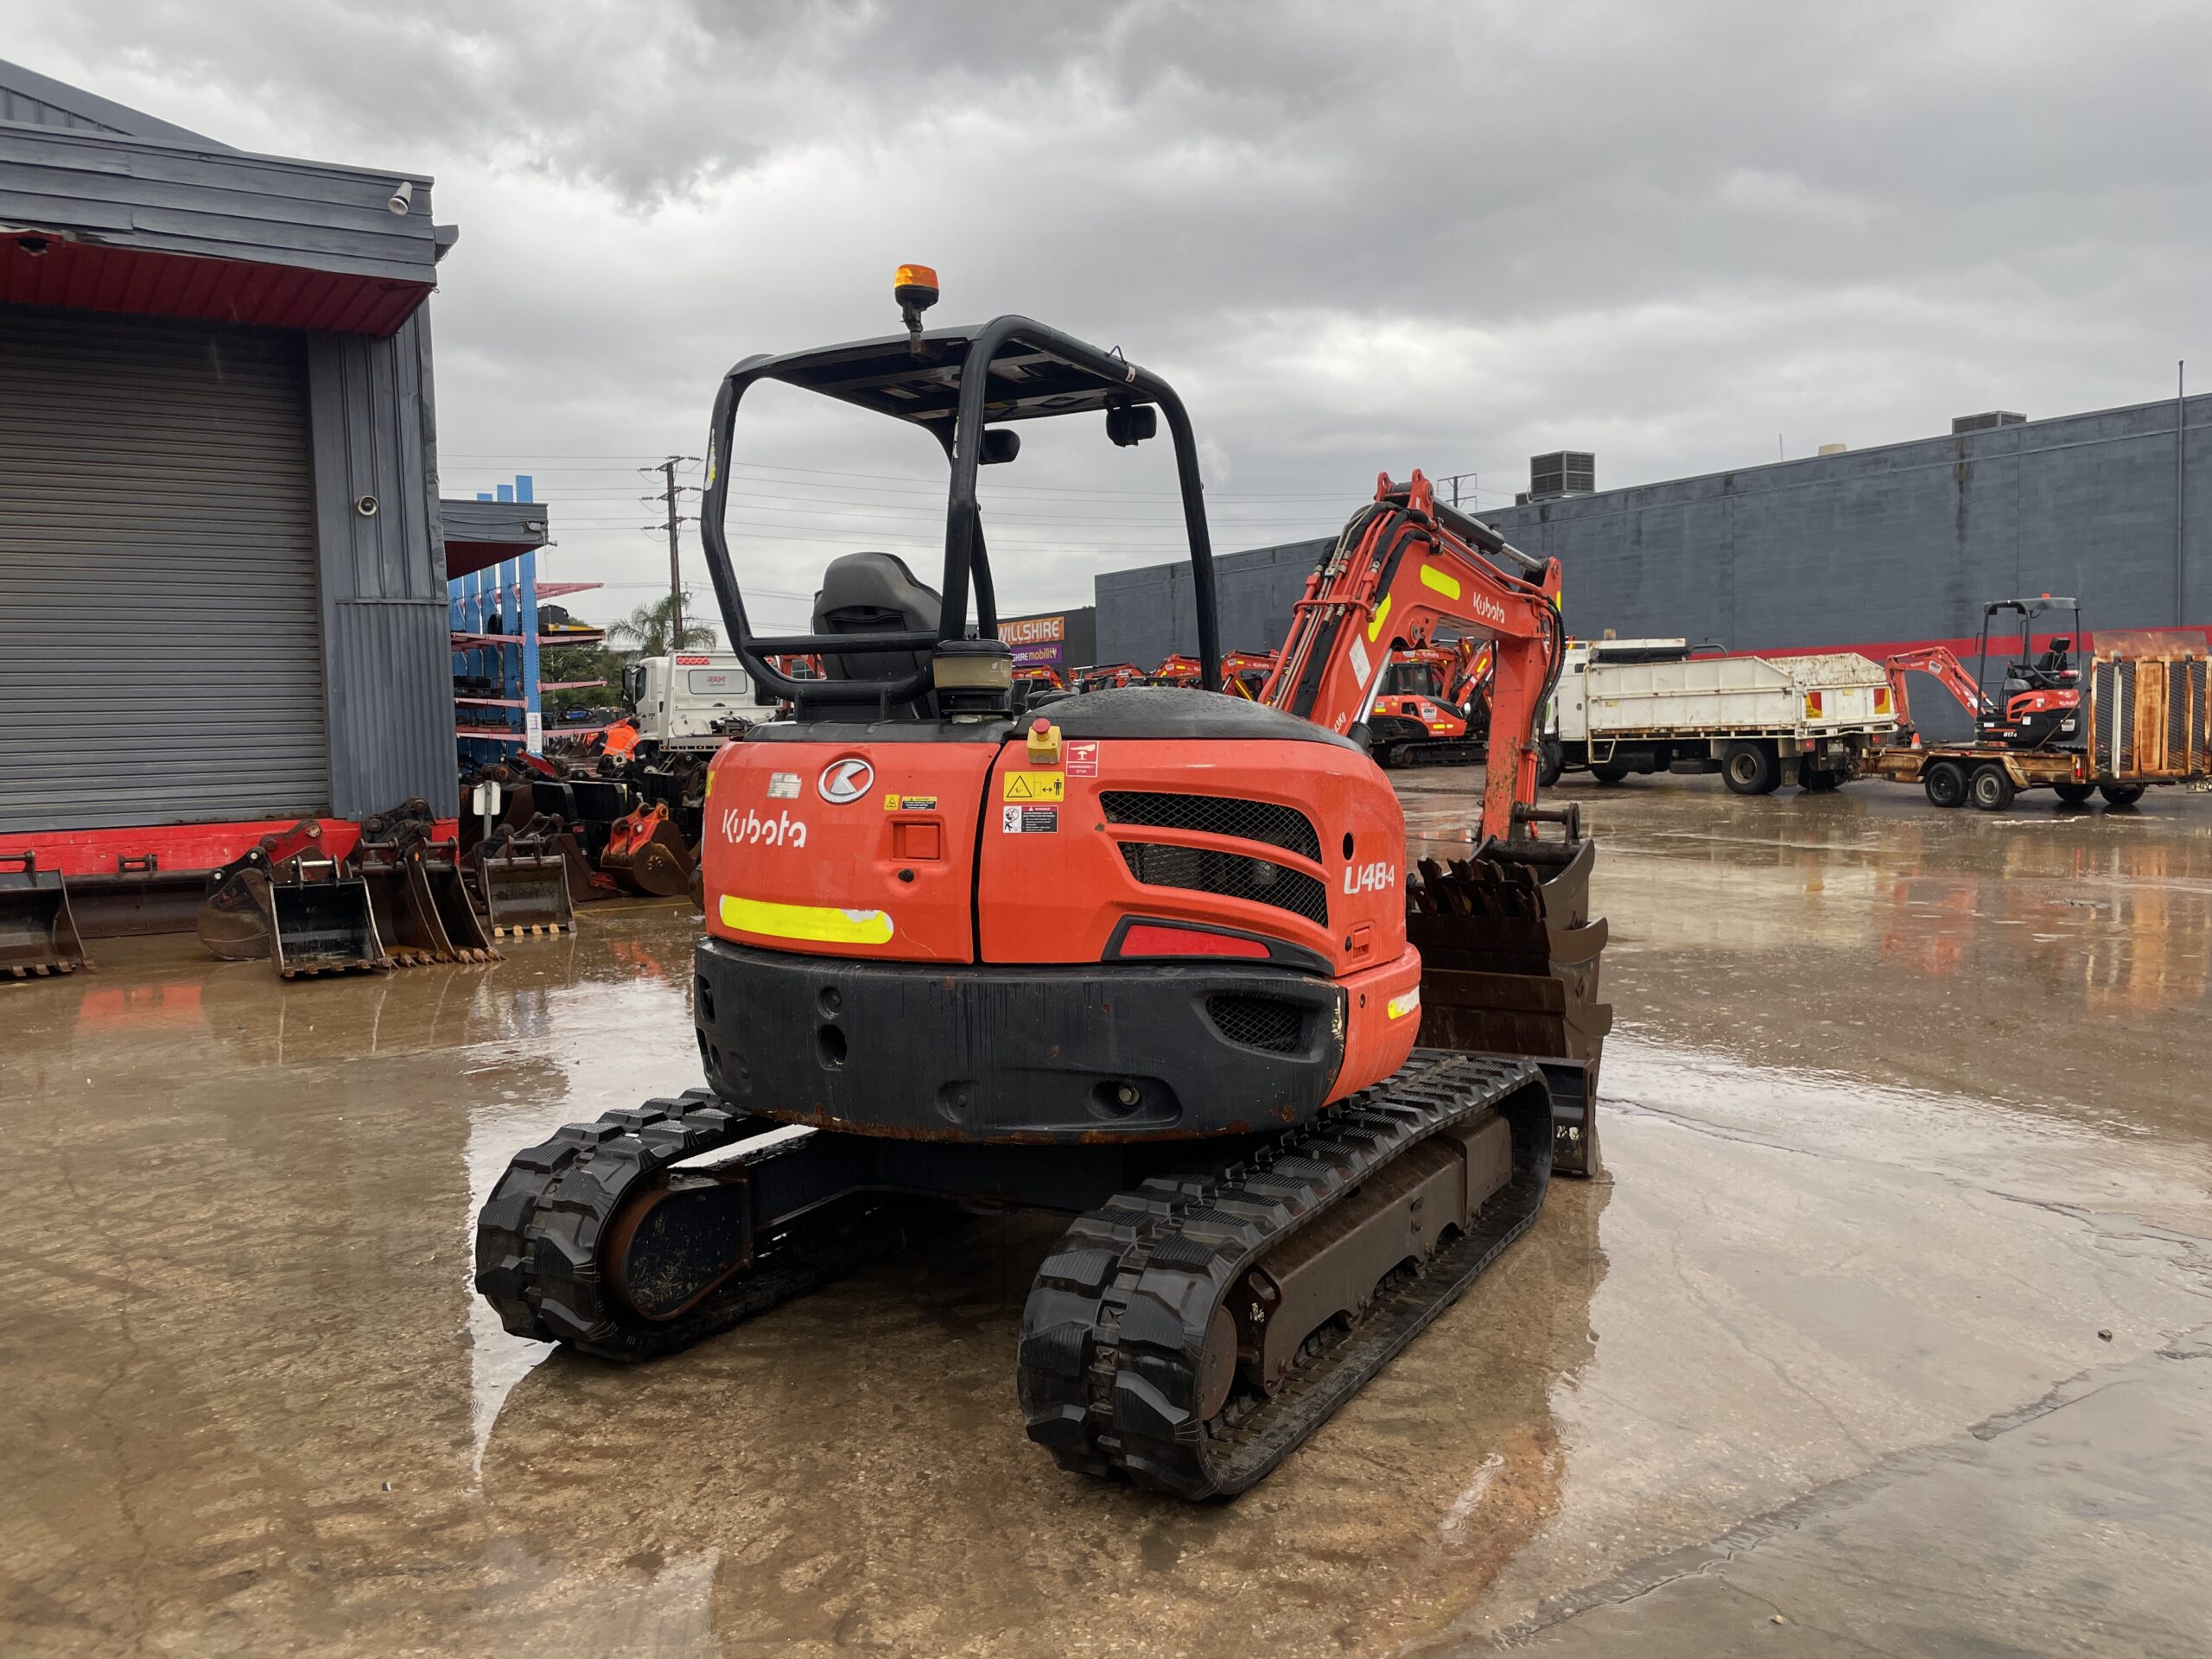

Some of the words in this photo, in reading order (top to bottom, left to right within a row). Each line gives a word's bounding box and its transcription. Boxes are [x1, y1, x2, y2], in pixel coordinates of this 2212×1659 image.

[1473, 592, 1504, 624] Kubota
[998, 620, 1059, 642] WILLSHIRE
[1012, 652, 1028, 662] SHIRE
[1332, 711, 1346, 734] 43Kg
[721, 809, 807, 848] Kubota
[1344, 861, 1395, 894] U48-4
